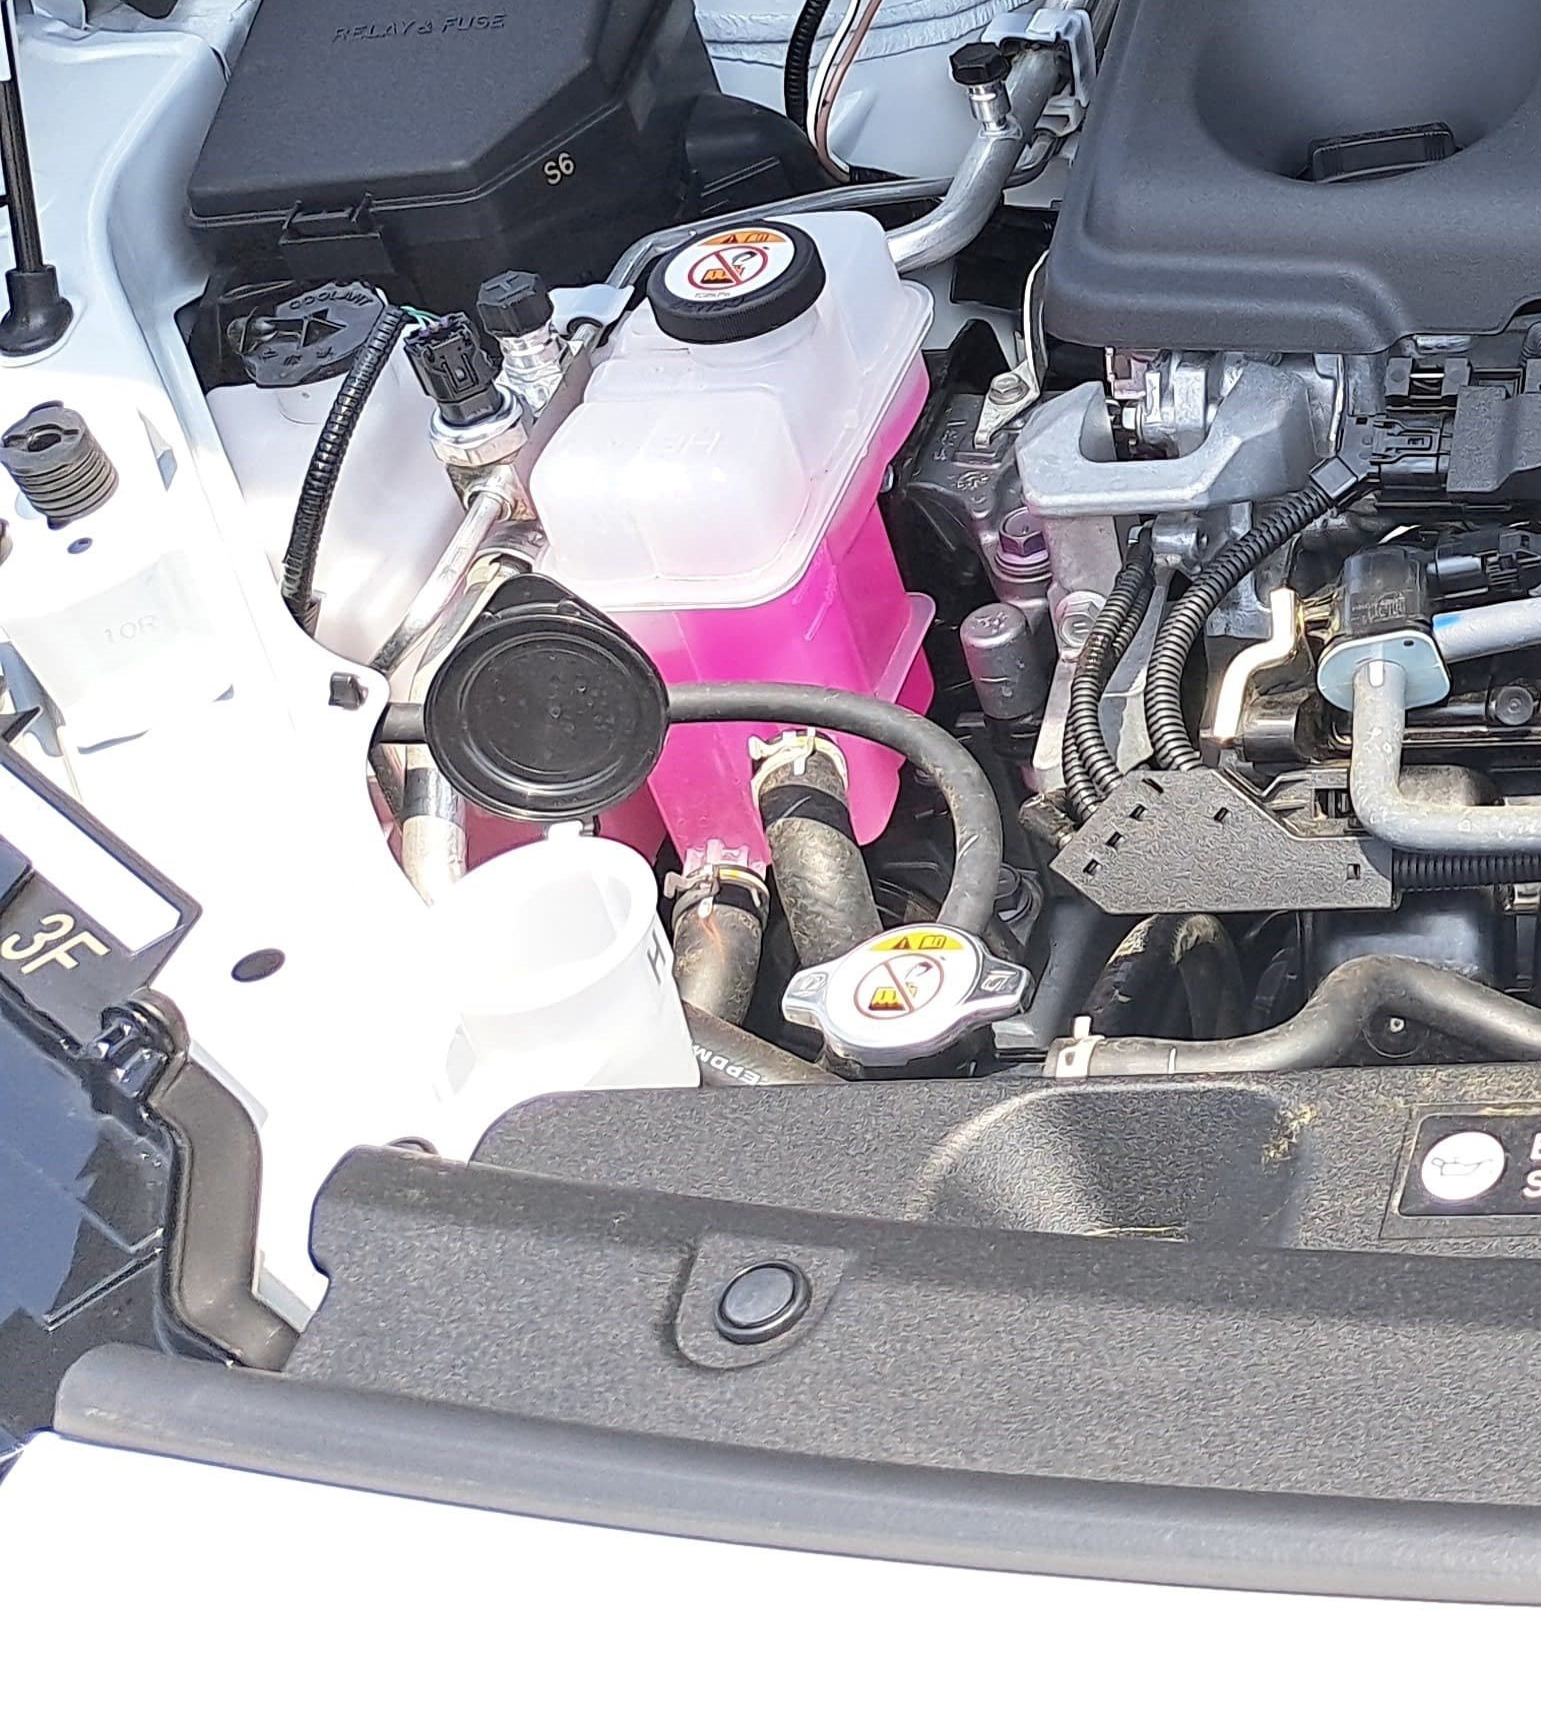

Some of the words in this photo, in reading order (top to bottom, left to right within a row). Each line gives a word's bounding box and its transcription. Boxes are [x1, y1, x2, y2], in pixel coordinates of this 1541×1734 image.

[332, 19, 416, 43] RELAY
[441, 13, 508, 34] FUSE
[543, 152, 575, 185] S6
[1, 913, 112, 975] 3F
